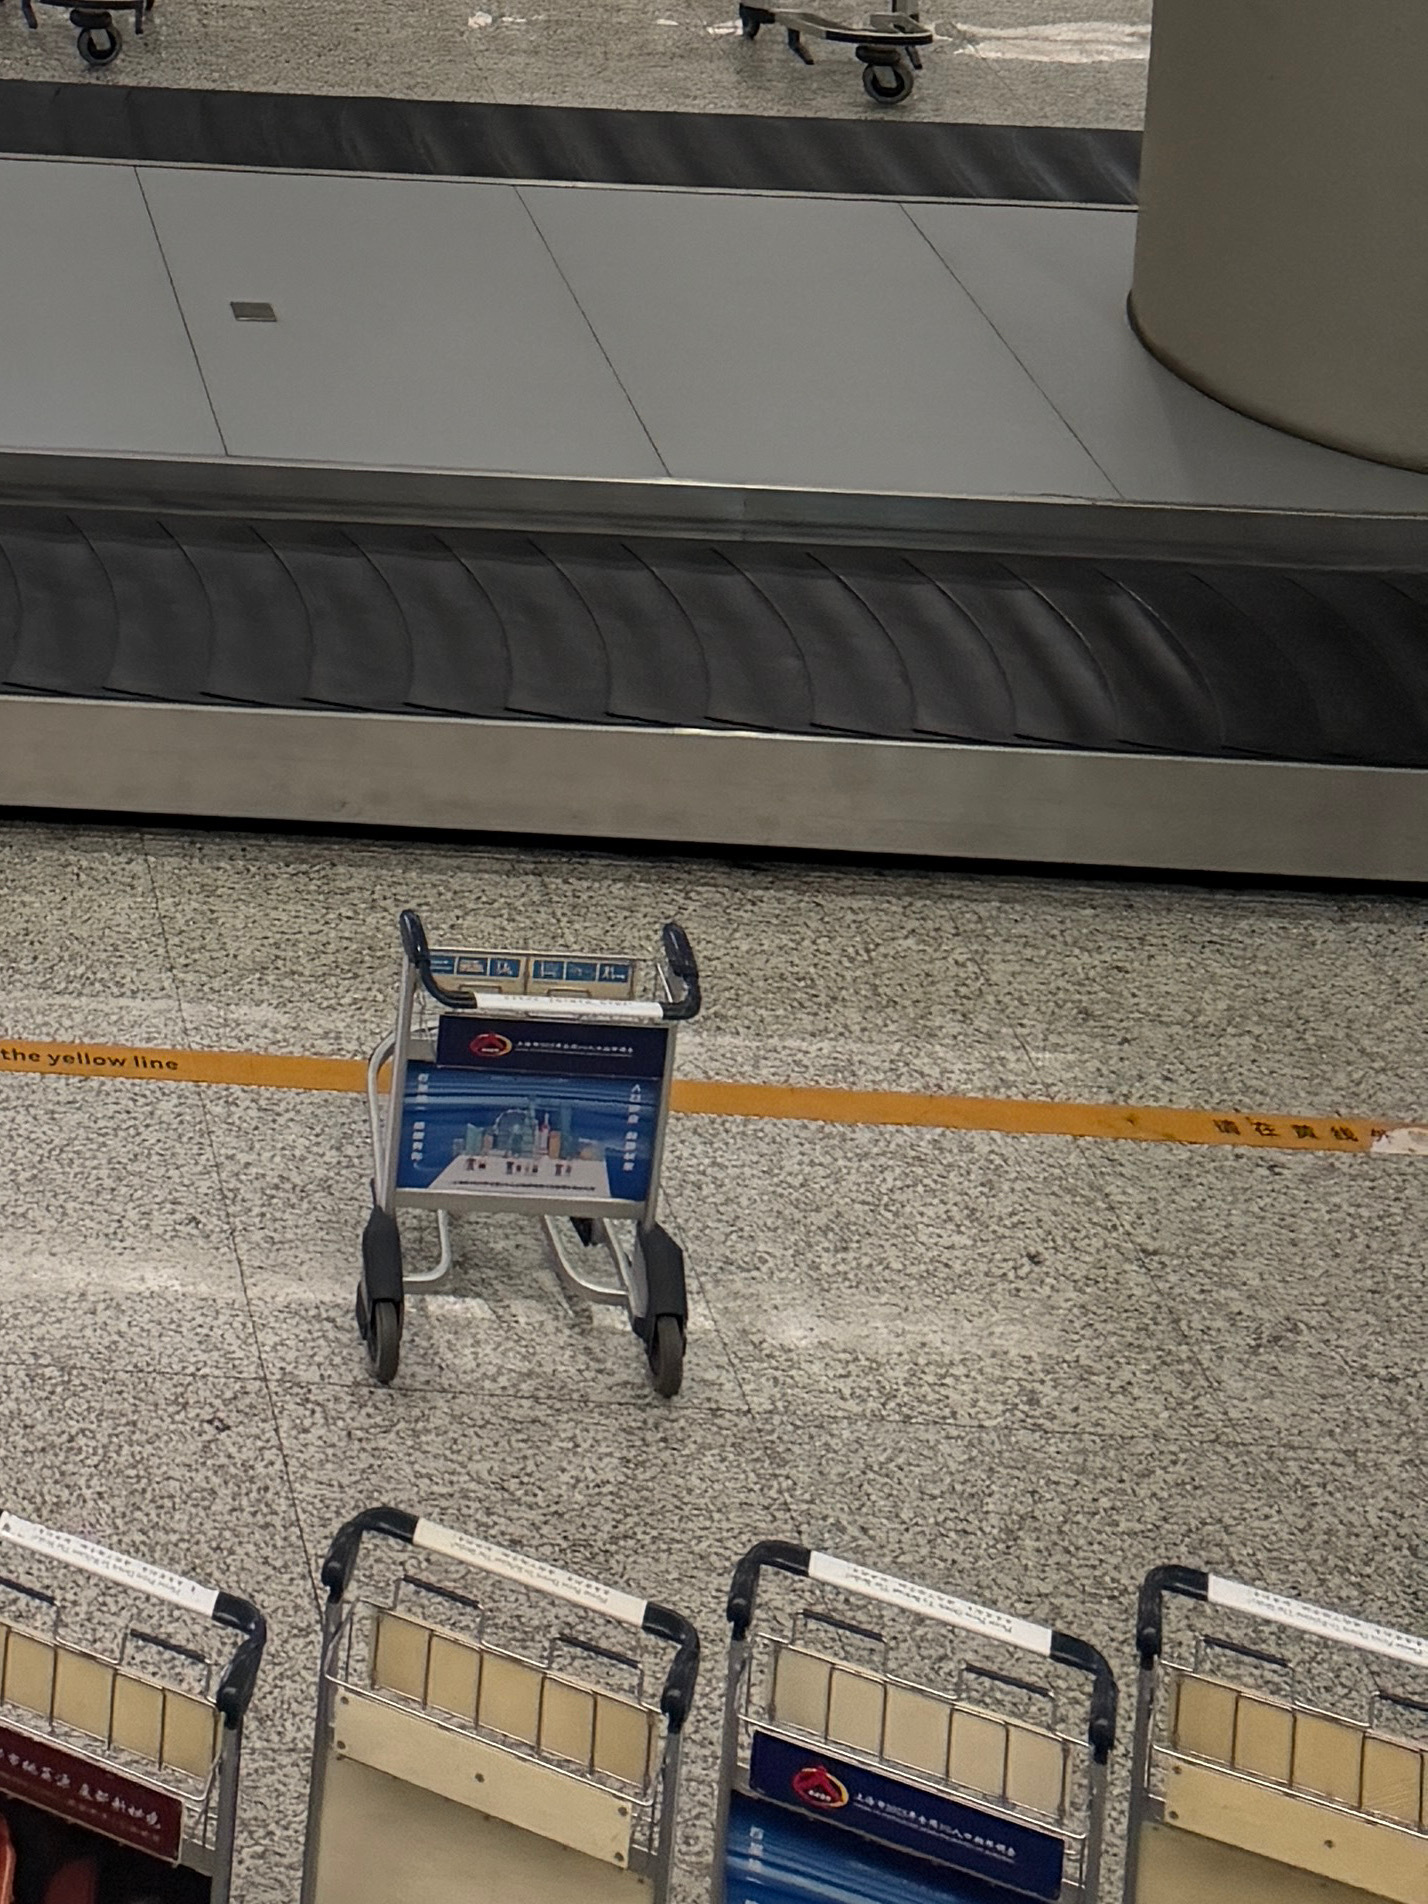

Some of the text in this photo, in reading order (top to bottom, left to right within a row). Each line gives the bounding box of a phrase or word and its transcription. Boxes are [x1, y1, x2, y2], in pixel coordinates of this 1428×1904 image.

[1, 1048, 40, 1062] the
[47, 1050, 126, 1068] yellow
[134, 1055, 178, 1071] line
